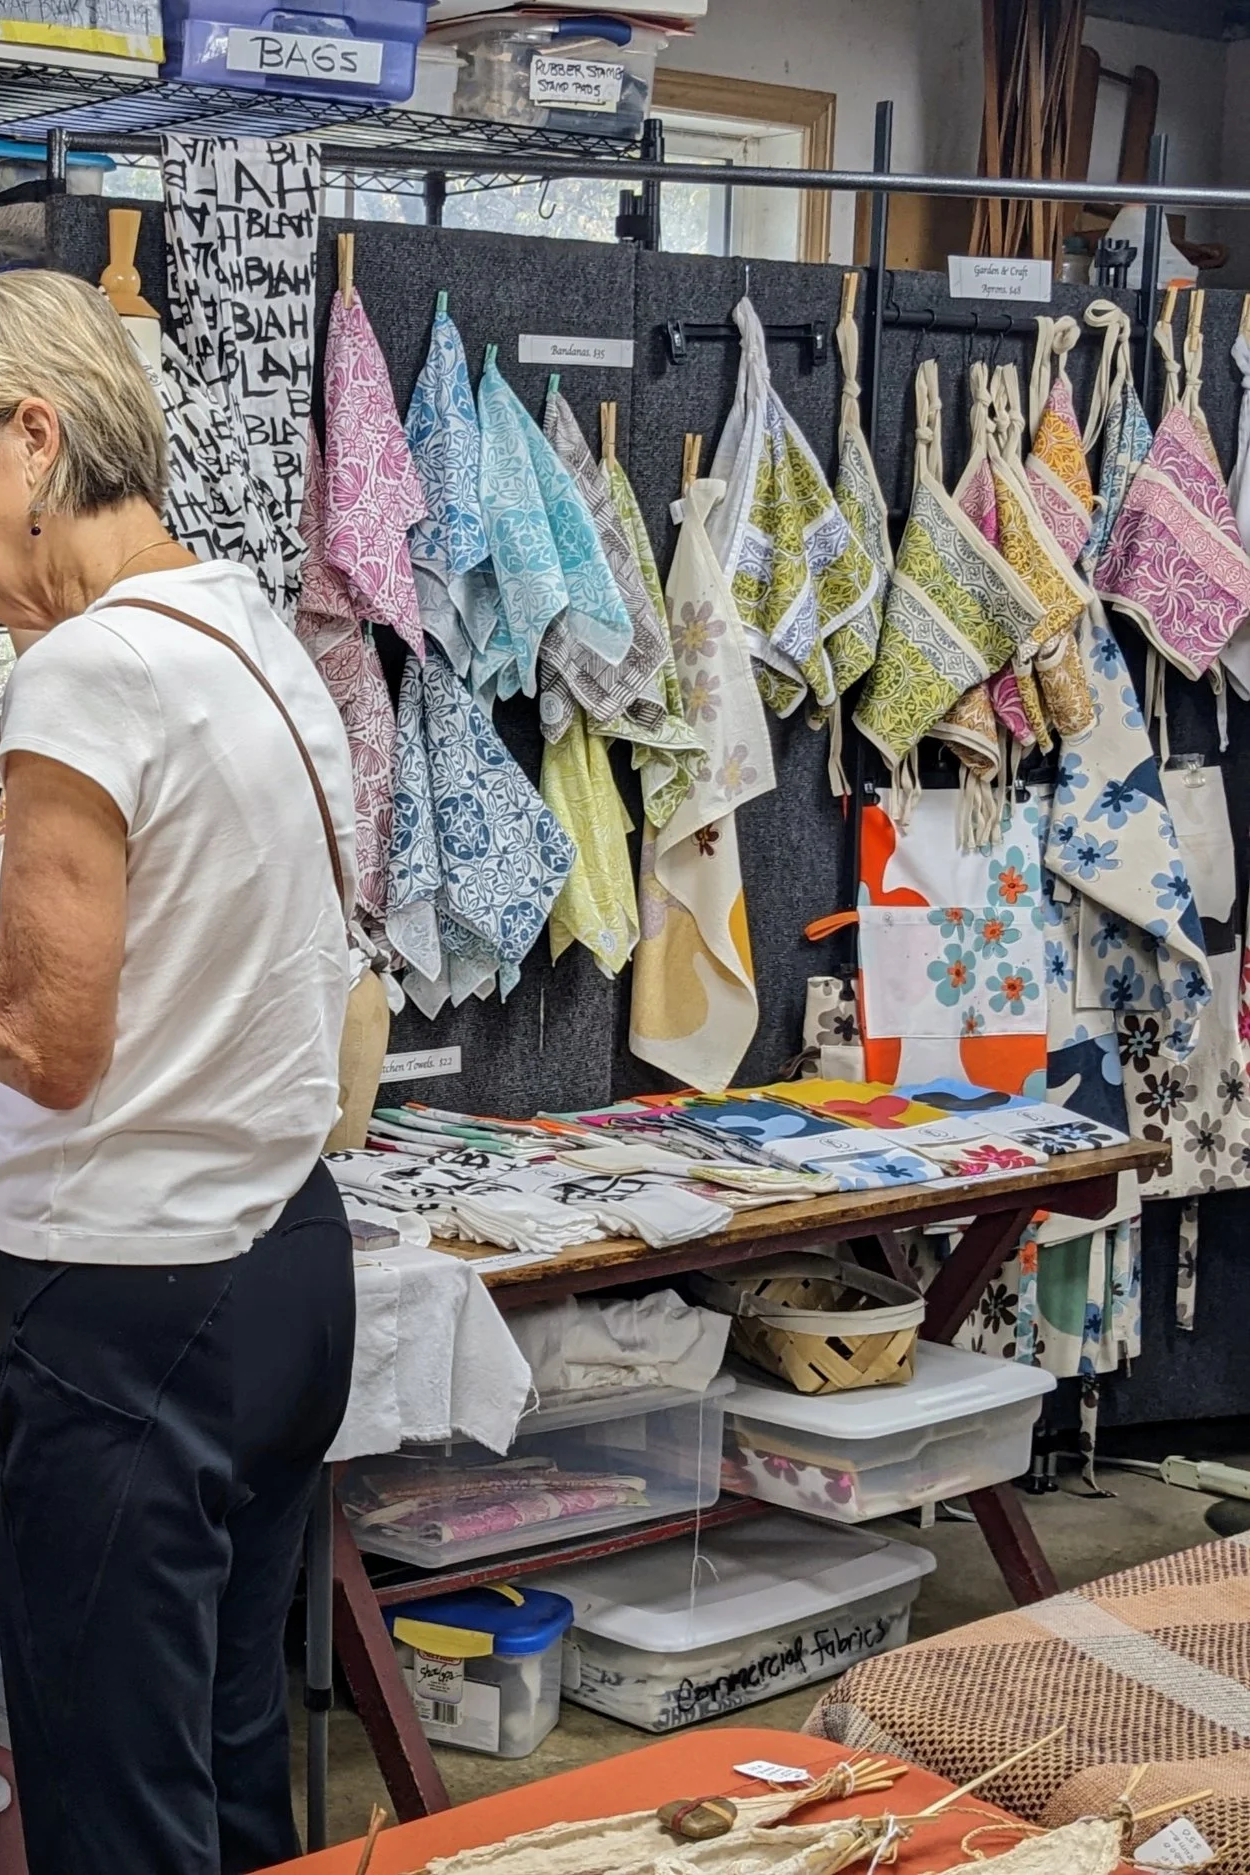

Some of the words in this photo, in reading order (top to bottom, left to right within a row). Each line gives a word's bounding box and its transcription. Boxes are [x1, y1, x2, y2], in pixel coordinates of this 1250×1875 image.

[250, 36, 358, 76] BAGS
[535, 59, 585, 78] RUBBER
[537, 79, 569, 92] STAMP
[572, 82, 601, 97] PADS
[244, 256, 311, 298] BLAH
[973, 263, 1000, 278] Garden
[1001, 266, 1010, 276] &
[1010, 265, 1028, 281] Craft
[230, 301, 309, 344] BLAH
[593, 347, 606, 359] $35
[439, 1057, 453, 1068] $22
